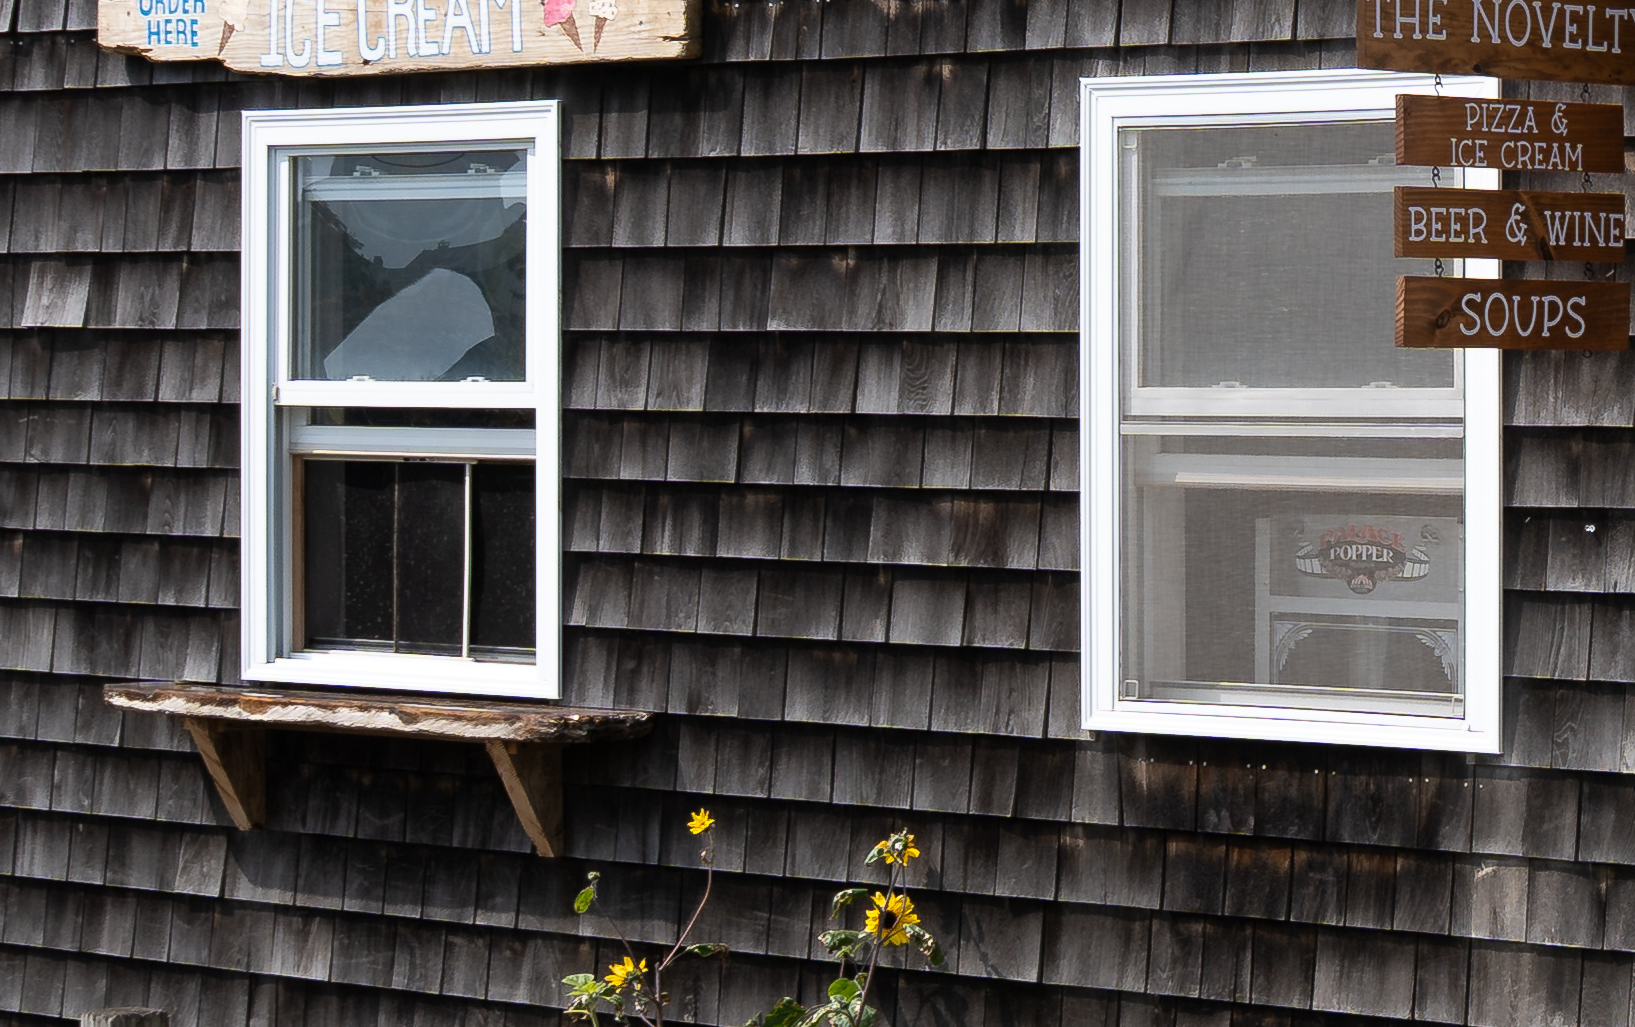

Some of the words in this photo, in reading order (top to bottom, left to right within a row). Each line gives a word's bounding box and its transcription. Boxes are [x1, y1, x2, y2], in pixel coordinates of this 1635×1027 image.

[147, 18, 199, 47] HERE
[1464, 102, 1539, 135] PIZZA
[1551, 103, 1569, 137] &
[1450, 138, 1488, 168] ICE
[1500, 141, 1584, 172] CREAM
[1408, 206, 1489, 244] BEER
[1505, 202, 1528, 247] &
[1544, 210, 1625, 248] WINE
[1459, 292, 1587, 339] SOUPS
[1319, 525, 1406, 553] PALACE
[1330, 545, 1394, 563] POPPER
